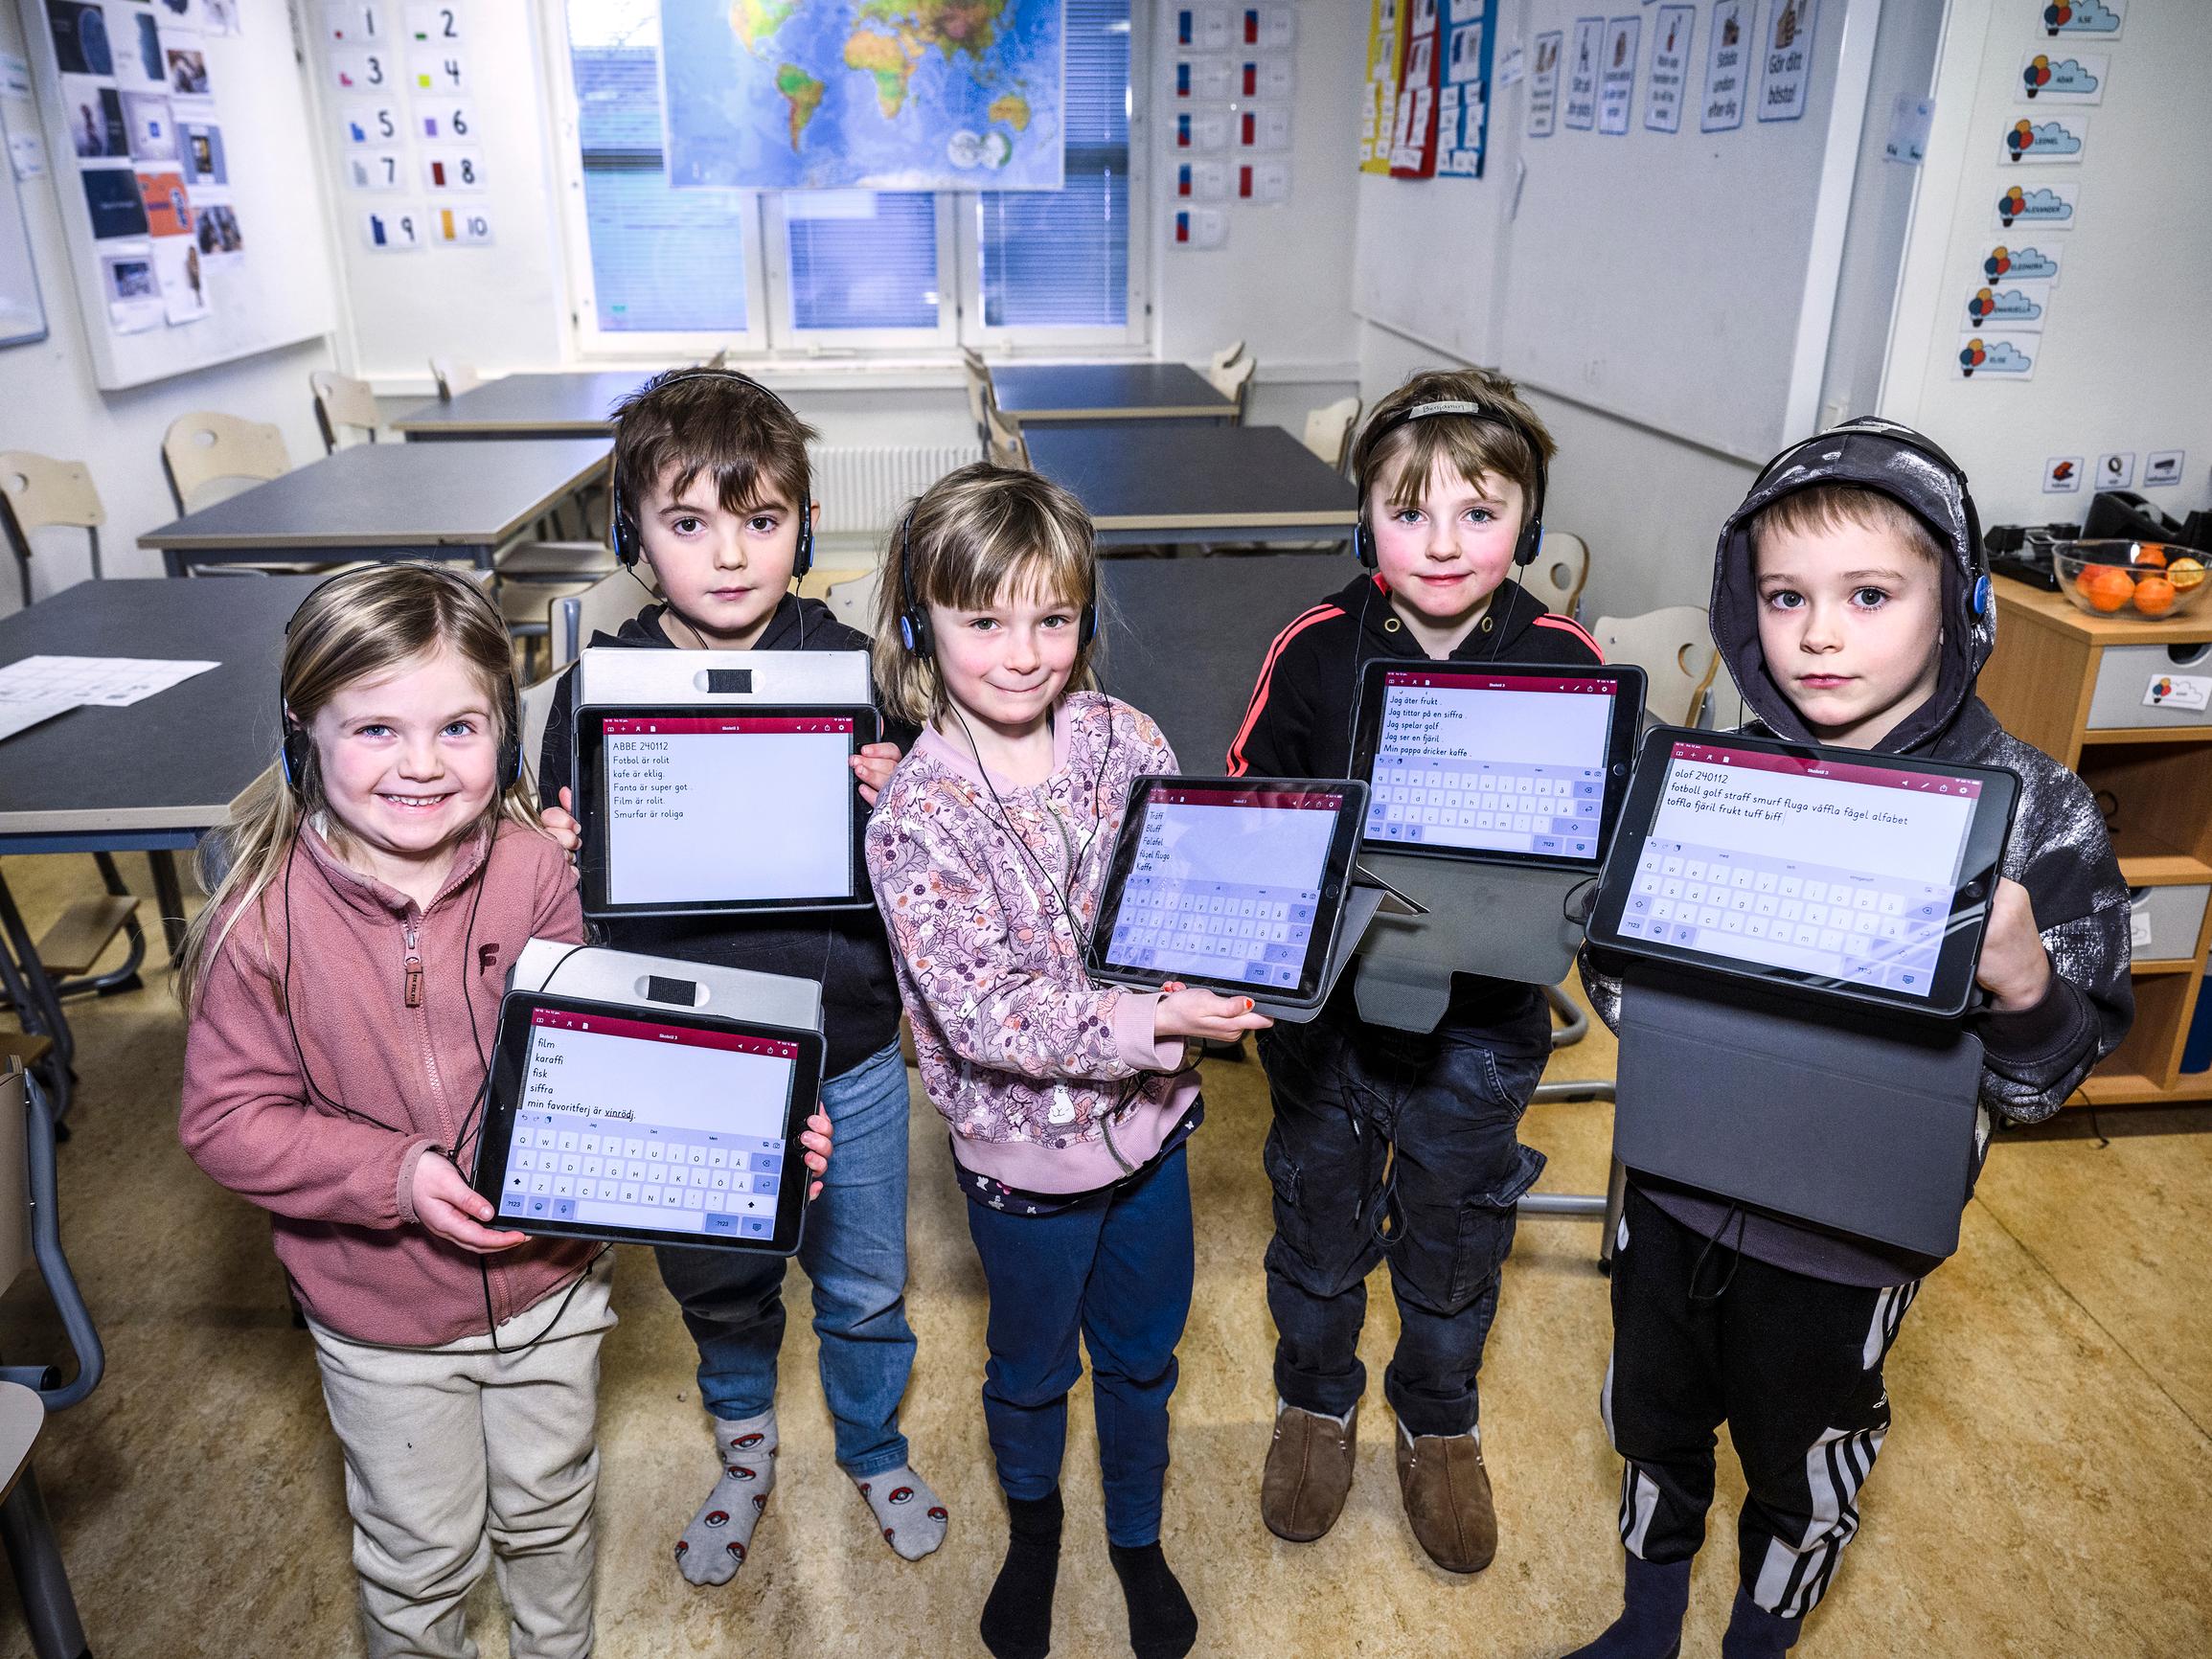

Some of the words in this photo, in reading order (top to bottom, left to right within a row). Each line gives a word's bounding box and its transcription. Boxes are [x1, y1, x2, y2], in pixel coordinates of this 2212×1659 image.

[367, 9, 374, 35] 1
[441, 10, 457, 37] 2
[368, 57, 382, 84] 3
[445, 60, 460, 85] 4
[378, 110, 394, 137] 5
[453, 110, 467, 135] 6
[381, 157, 394, 183] 7
[461, 159, 474, 184] 8
[401, 216, 415, 242] 9
[467, 216, 487, 236] 10
[1390, 696, 1402, 706] Jag
[1389, 708, 1400, 718] Jag
[1422, 710, 1430, 719] på
[1387, 720, 1399, 730] Jag
[1401, 722, 1422, 730] spelar
[1425, 722, 1439, 732] golf
[1385, 732, 1397, 742] Jag
[1423, 734, 1439, 744] fjäril
[613, 742, 636, 750] ABBE
[640, 742, 668, 750] 240112
[1423, 747, 1447, 755] dricker
[613, 756, 639, 764] Fotbol
[613, 769, 630, 777] kafe
[1675, 770, 1694, 779] olof
[1695, 771, 1728, 784] 240112
[613, 783, 637, 791] Fanta
[675, 784, 687, 793] got
[1666, 797, 1691, 808] toffla
[1694, 801, 1716, 813] fjäril
[1719, 804, 1741, 816] frukt
[1744, 809, 1763, 818] tuff
[1765, 810, 1783, 821] biff
[1671, 783, 1700, 795] fotboll
[1703, 789, 1723, 799] golf
[1724, 792, 1751, 802] straff
[1753, 796, 1782, 806] smurf
[1784, 799, 1808, 813] fluga
[1844, 807, 1868, 821] fågel
[1872, 812, 1908, 825] alfabet
[615, 810, 647, 818] Smurfar
[661, 810, 683, 820] roliga
[1146, 824, 1162, 833] Bluff
[1143, 837, 1163, 845] Falafel
[1136, 863, 1152, 871] Kaffe
[538, 1038, 555, 1048] film
[536, 1053, 564, 1064] karaffi
[533, 1068, 547, 1078] fisk
[530, 1084, 553, 1094] siffra
[528, 1100, 544, 1108] min
[547, 1100, 590, 1117] favoritferj
[594, 1106, 602, 1115] är
